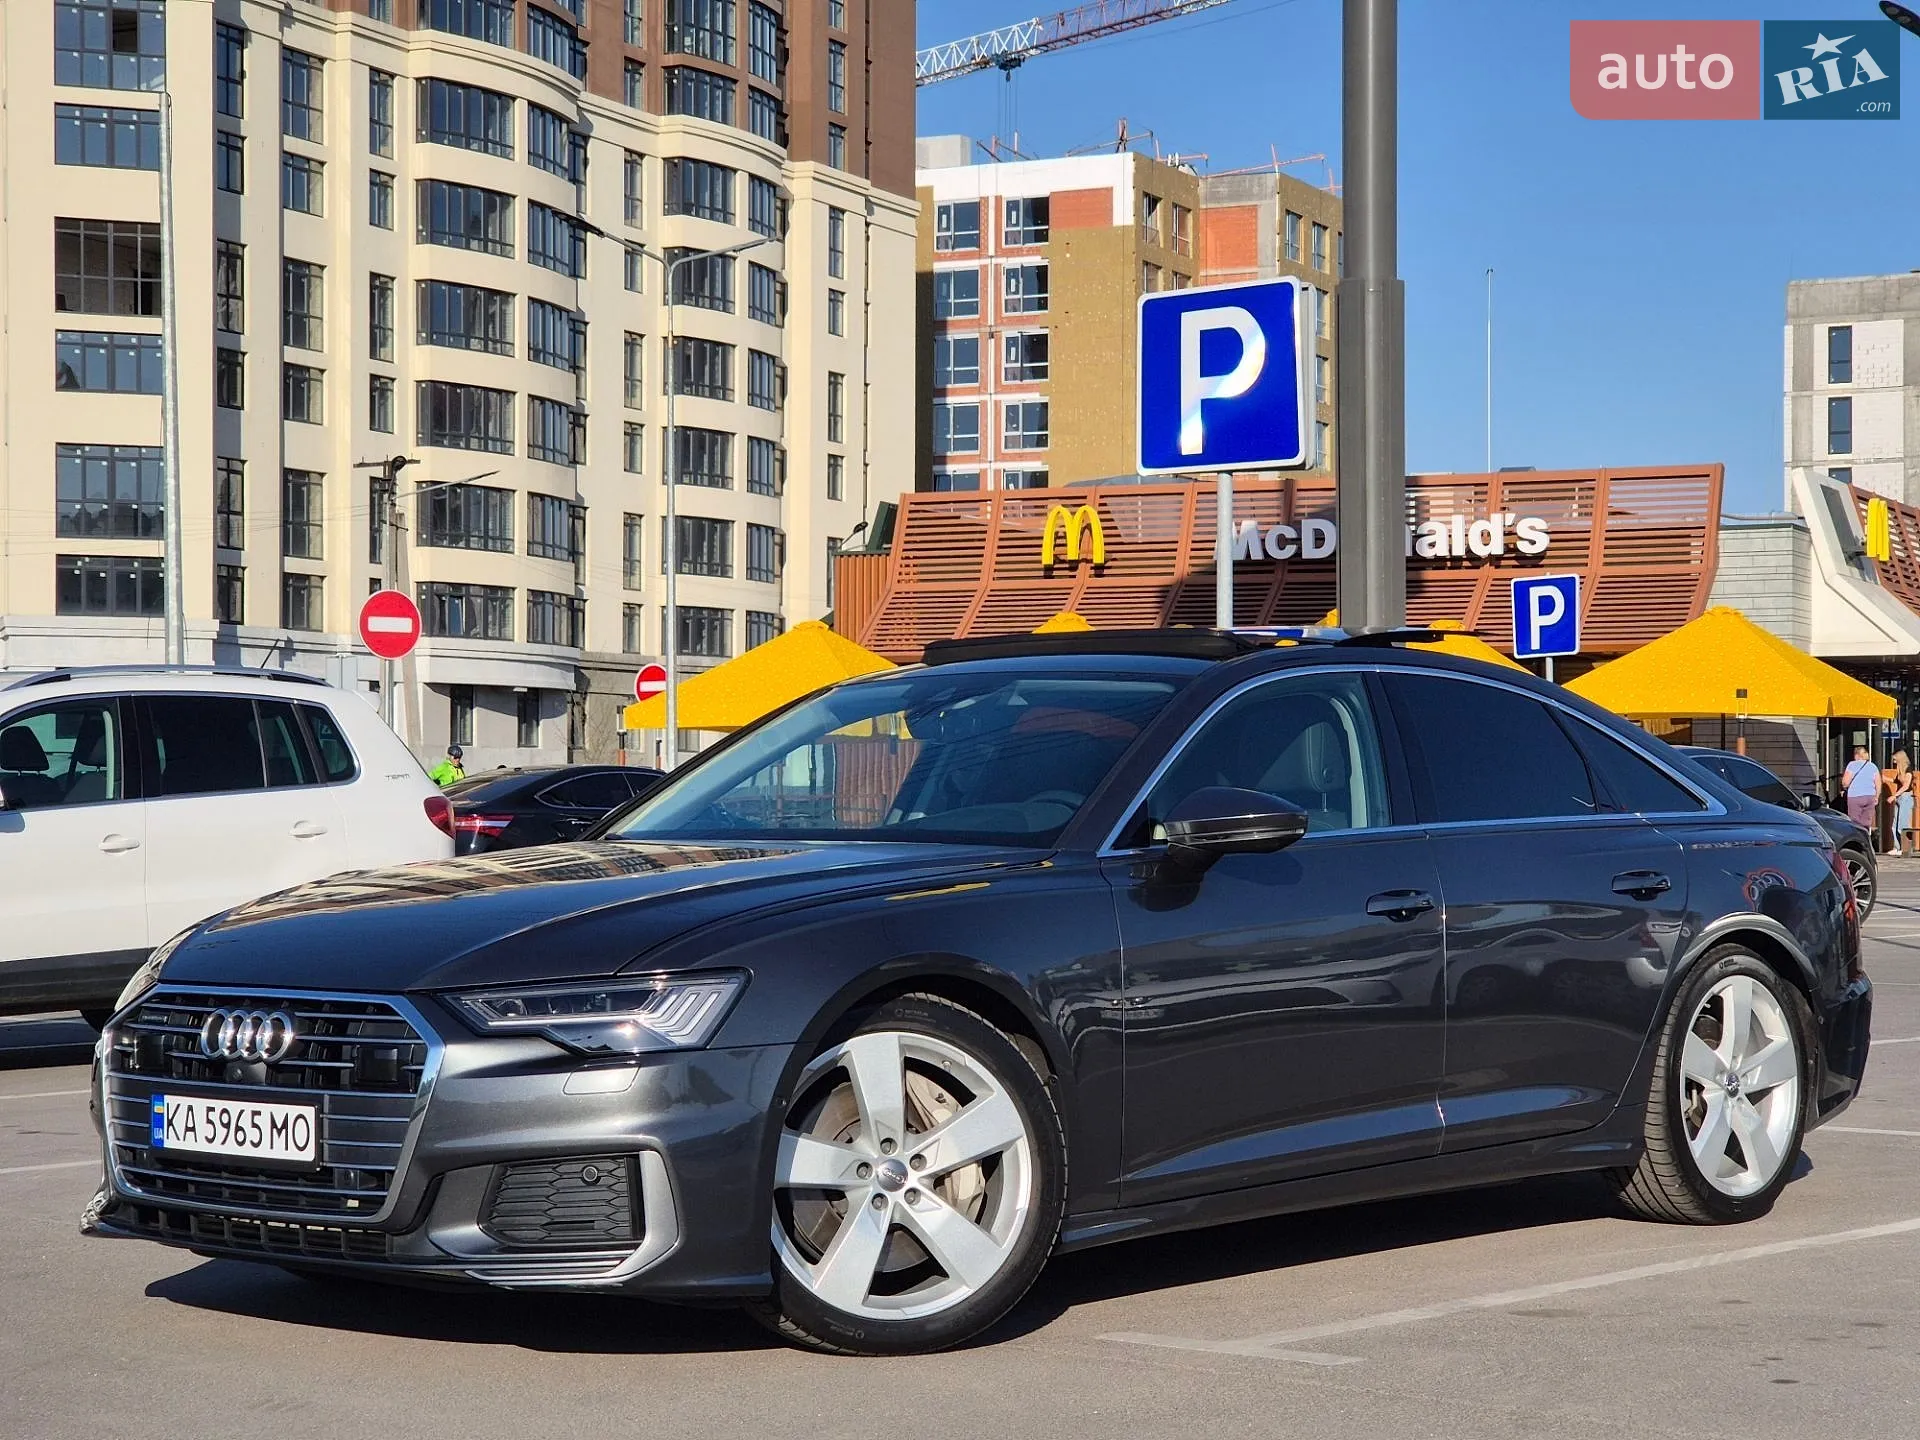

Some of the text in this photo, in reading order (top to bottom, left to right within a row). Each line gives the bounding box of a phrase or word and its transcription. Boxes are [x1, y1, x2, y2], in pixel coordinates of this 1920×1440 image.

[1181, 306, 1266, 456] P
[1214, 513, 1550, 560] McDald's
[1529, 585, 1565, 650] P
[153, 1127, 164, 1140] UA
[166, 1102, 310, 1152] KA 5965 MO
